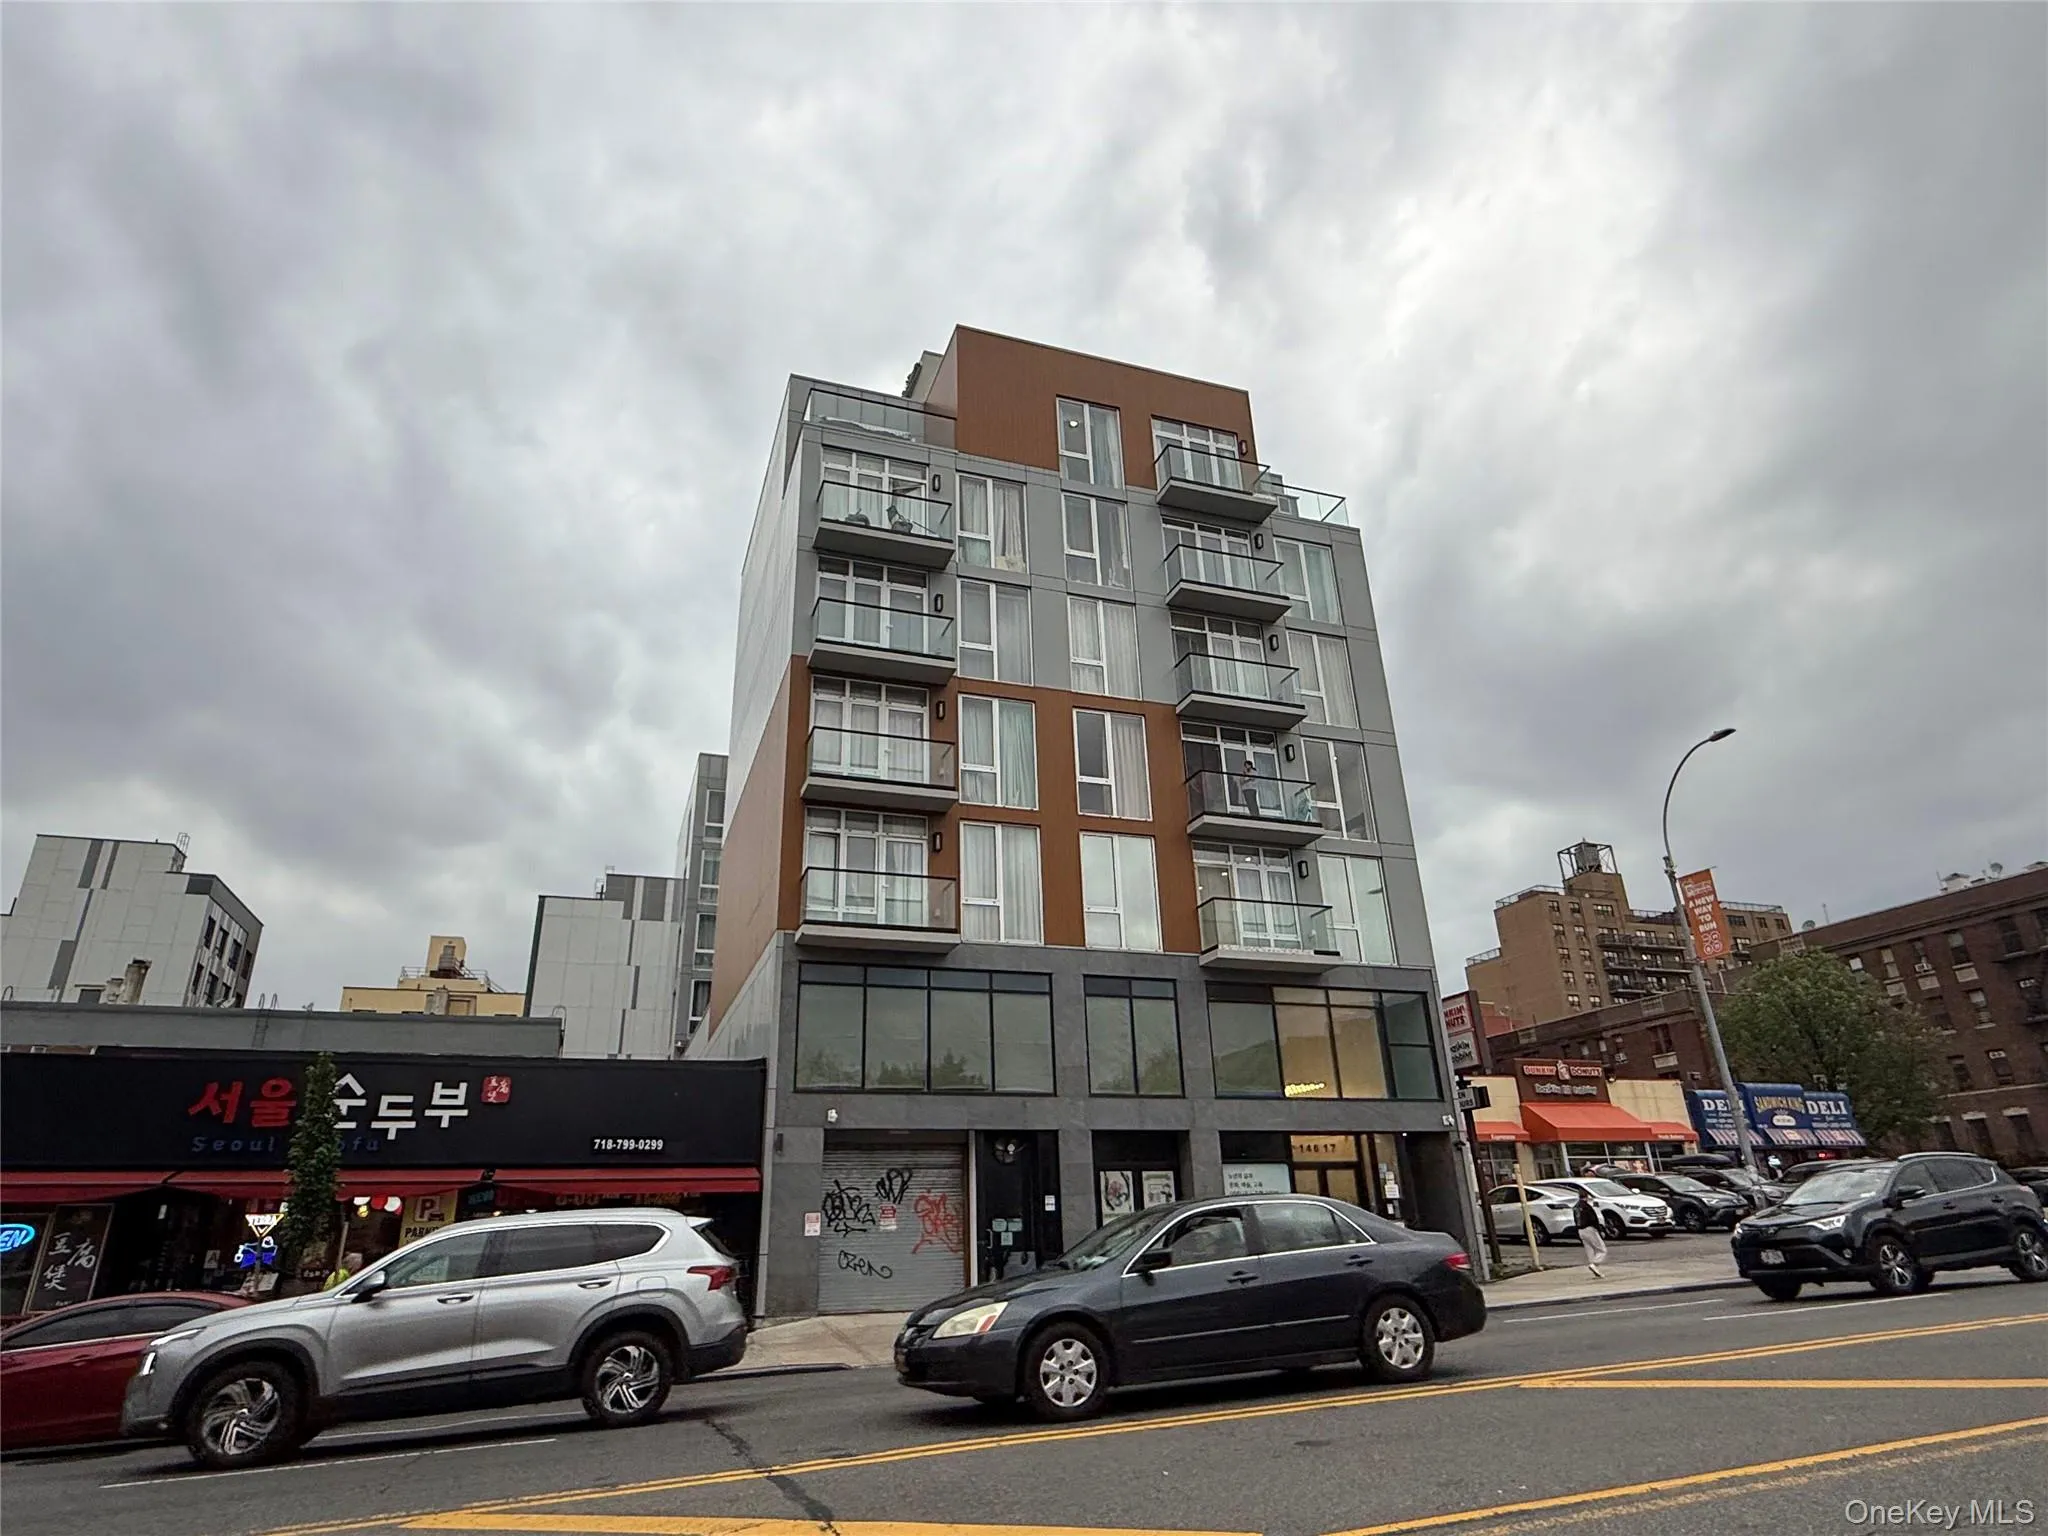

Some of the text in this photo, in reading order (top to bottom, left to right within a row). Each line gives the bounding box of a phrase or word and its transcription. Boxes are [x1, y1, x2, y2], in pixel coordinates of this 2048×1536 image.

[1688, 894, 1715, 909] A NEW
[1694, 903, 1713, 916] WAY
[1699, 913, 1712, 923] TO
[187, 1077, 297, 1128] 서울
[1806, 1100, 1848, 1115] DELI
[593, 1138, 664, 1150] 718-799-0299
[0, 1230, 27, 1247] EN
